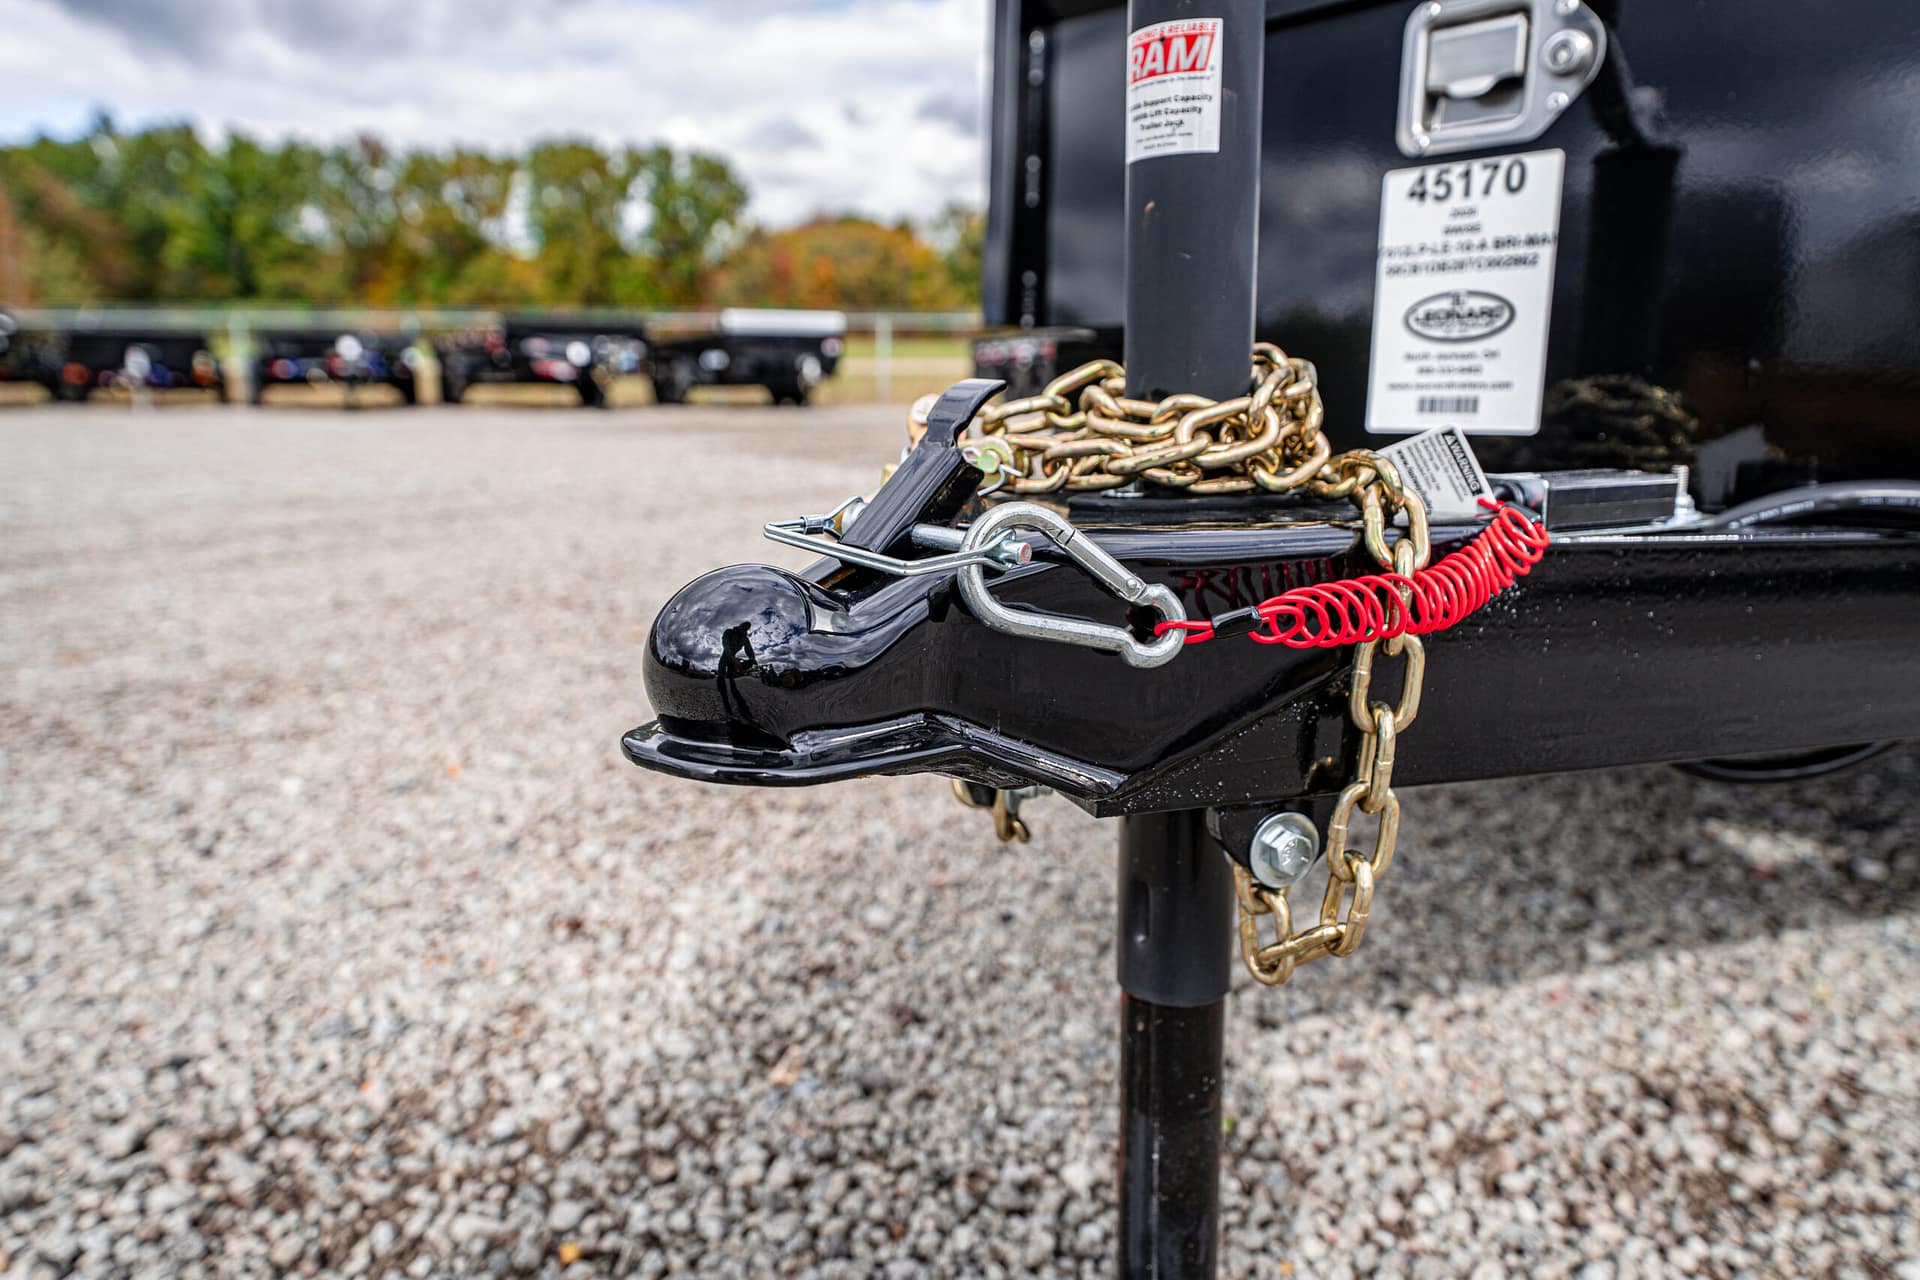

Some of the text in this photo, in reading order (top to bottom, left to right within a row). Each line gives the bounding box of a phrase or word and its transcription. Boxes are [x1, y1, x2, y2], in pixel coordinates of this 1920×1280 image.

[1168, 22, 1217, 33] RELIABLE
[1132, 35, 1211, 79] RAM
[1143, 97, 1171, 107] Support
[1174, 95, 1212, 103] Capacity
[1164, 106, 1202, 115] Capacity
[1408, 159, 1527, 203] 45170
[1449, 442, 1481, 492] WARNING
